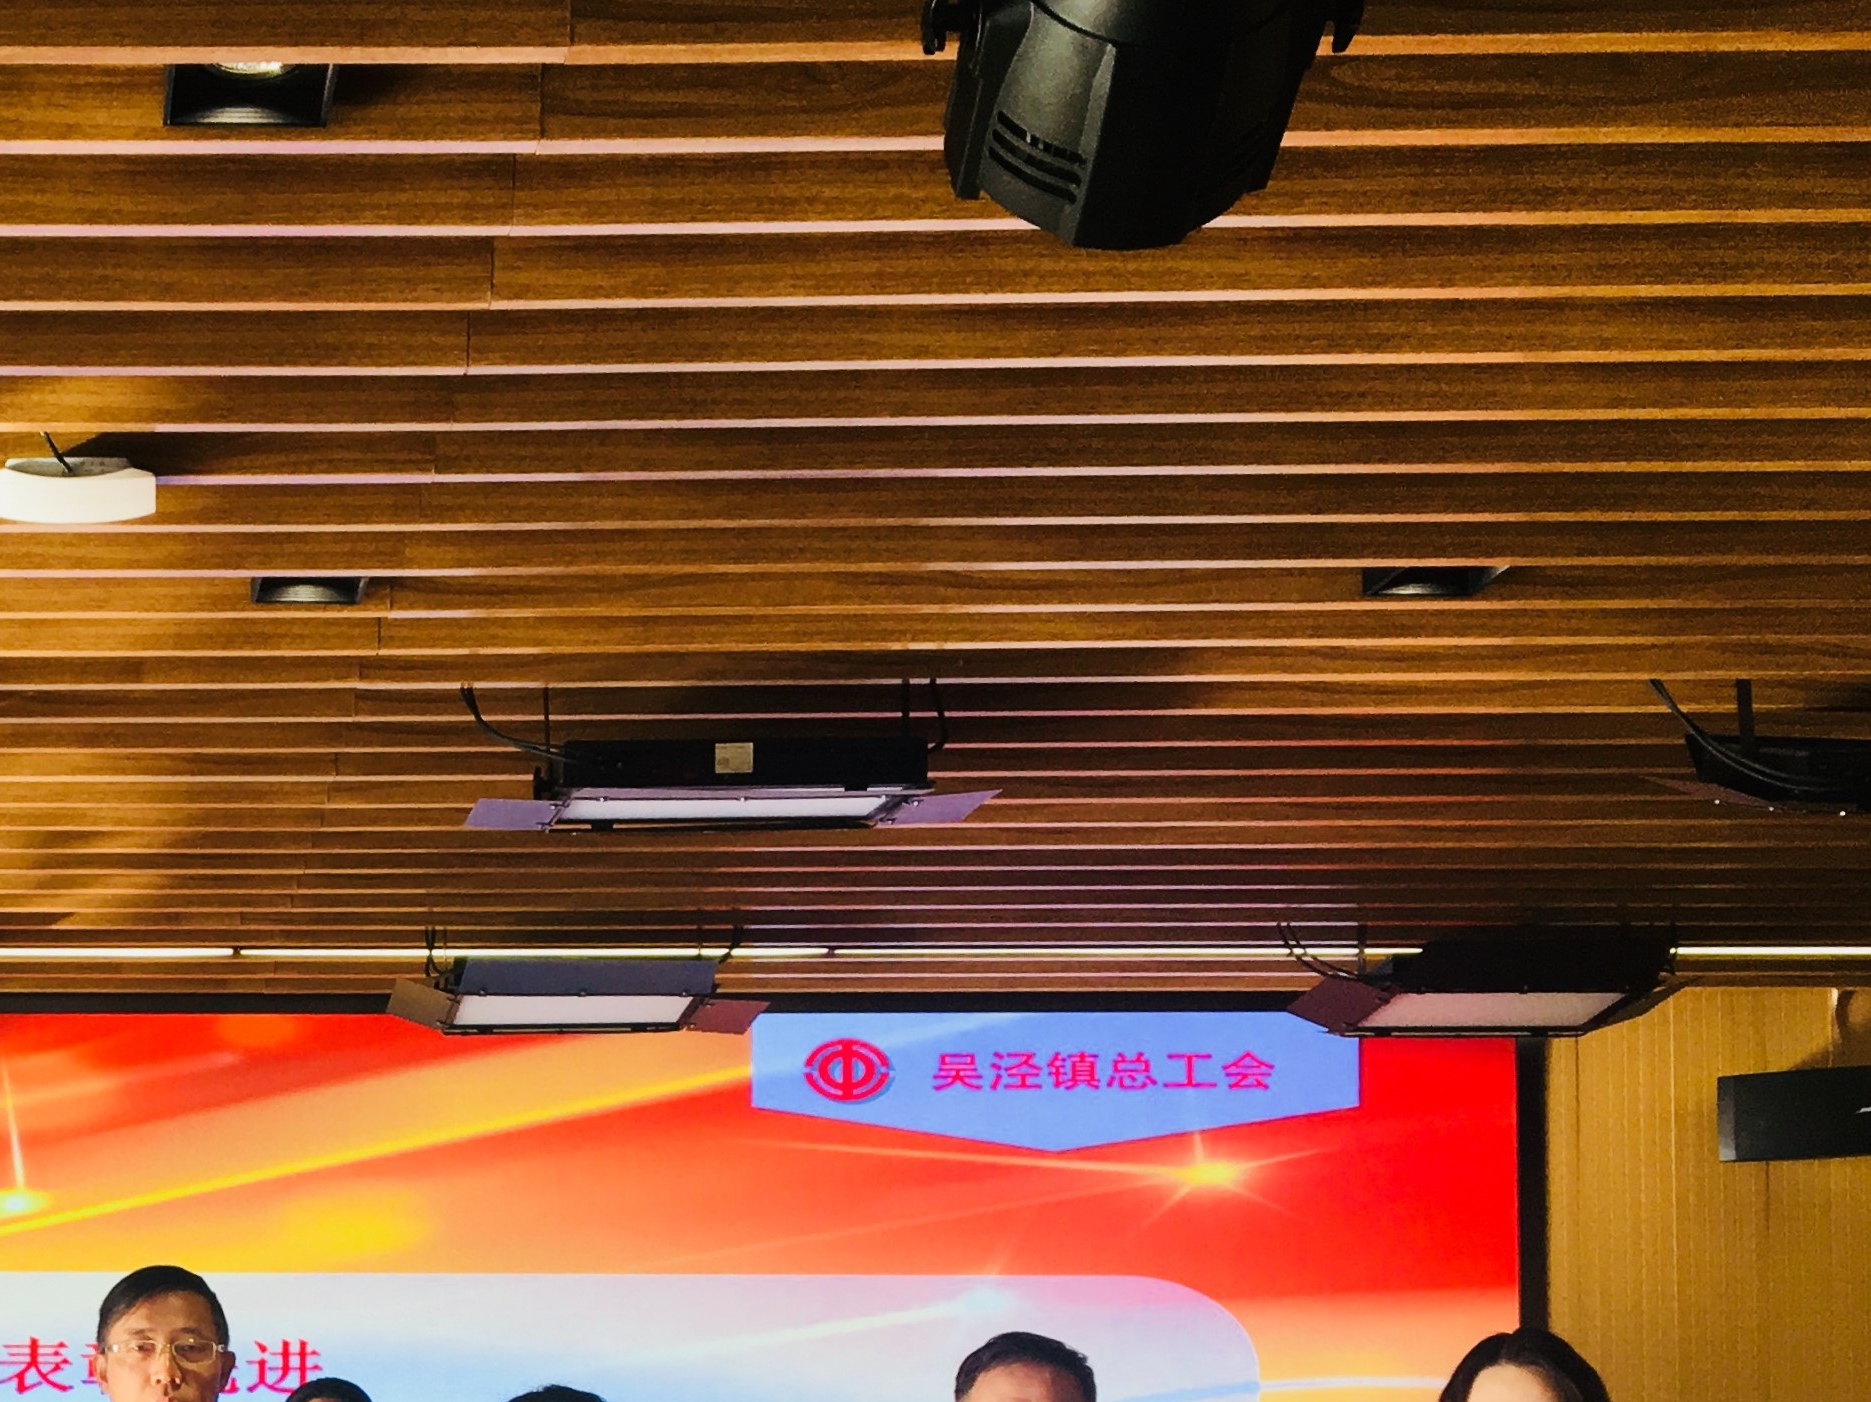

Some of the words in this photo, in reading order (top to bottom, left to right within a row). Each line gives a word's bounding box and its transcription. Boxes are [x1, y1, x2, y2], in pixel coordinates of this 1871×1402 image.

[932, 1050, 1276, 1092] 吴泾镇总工会
